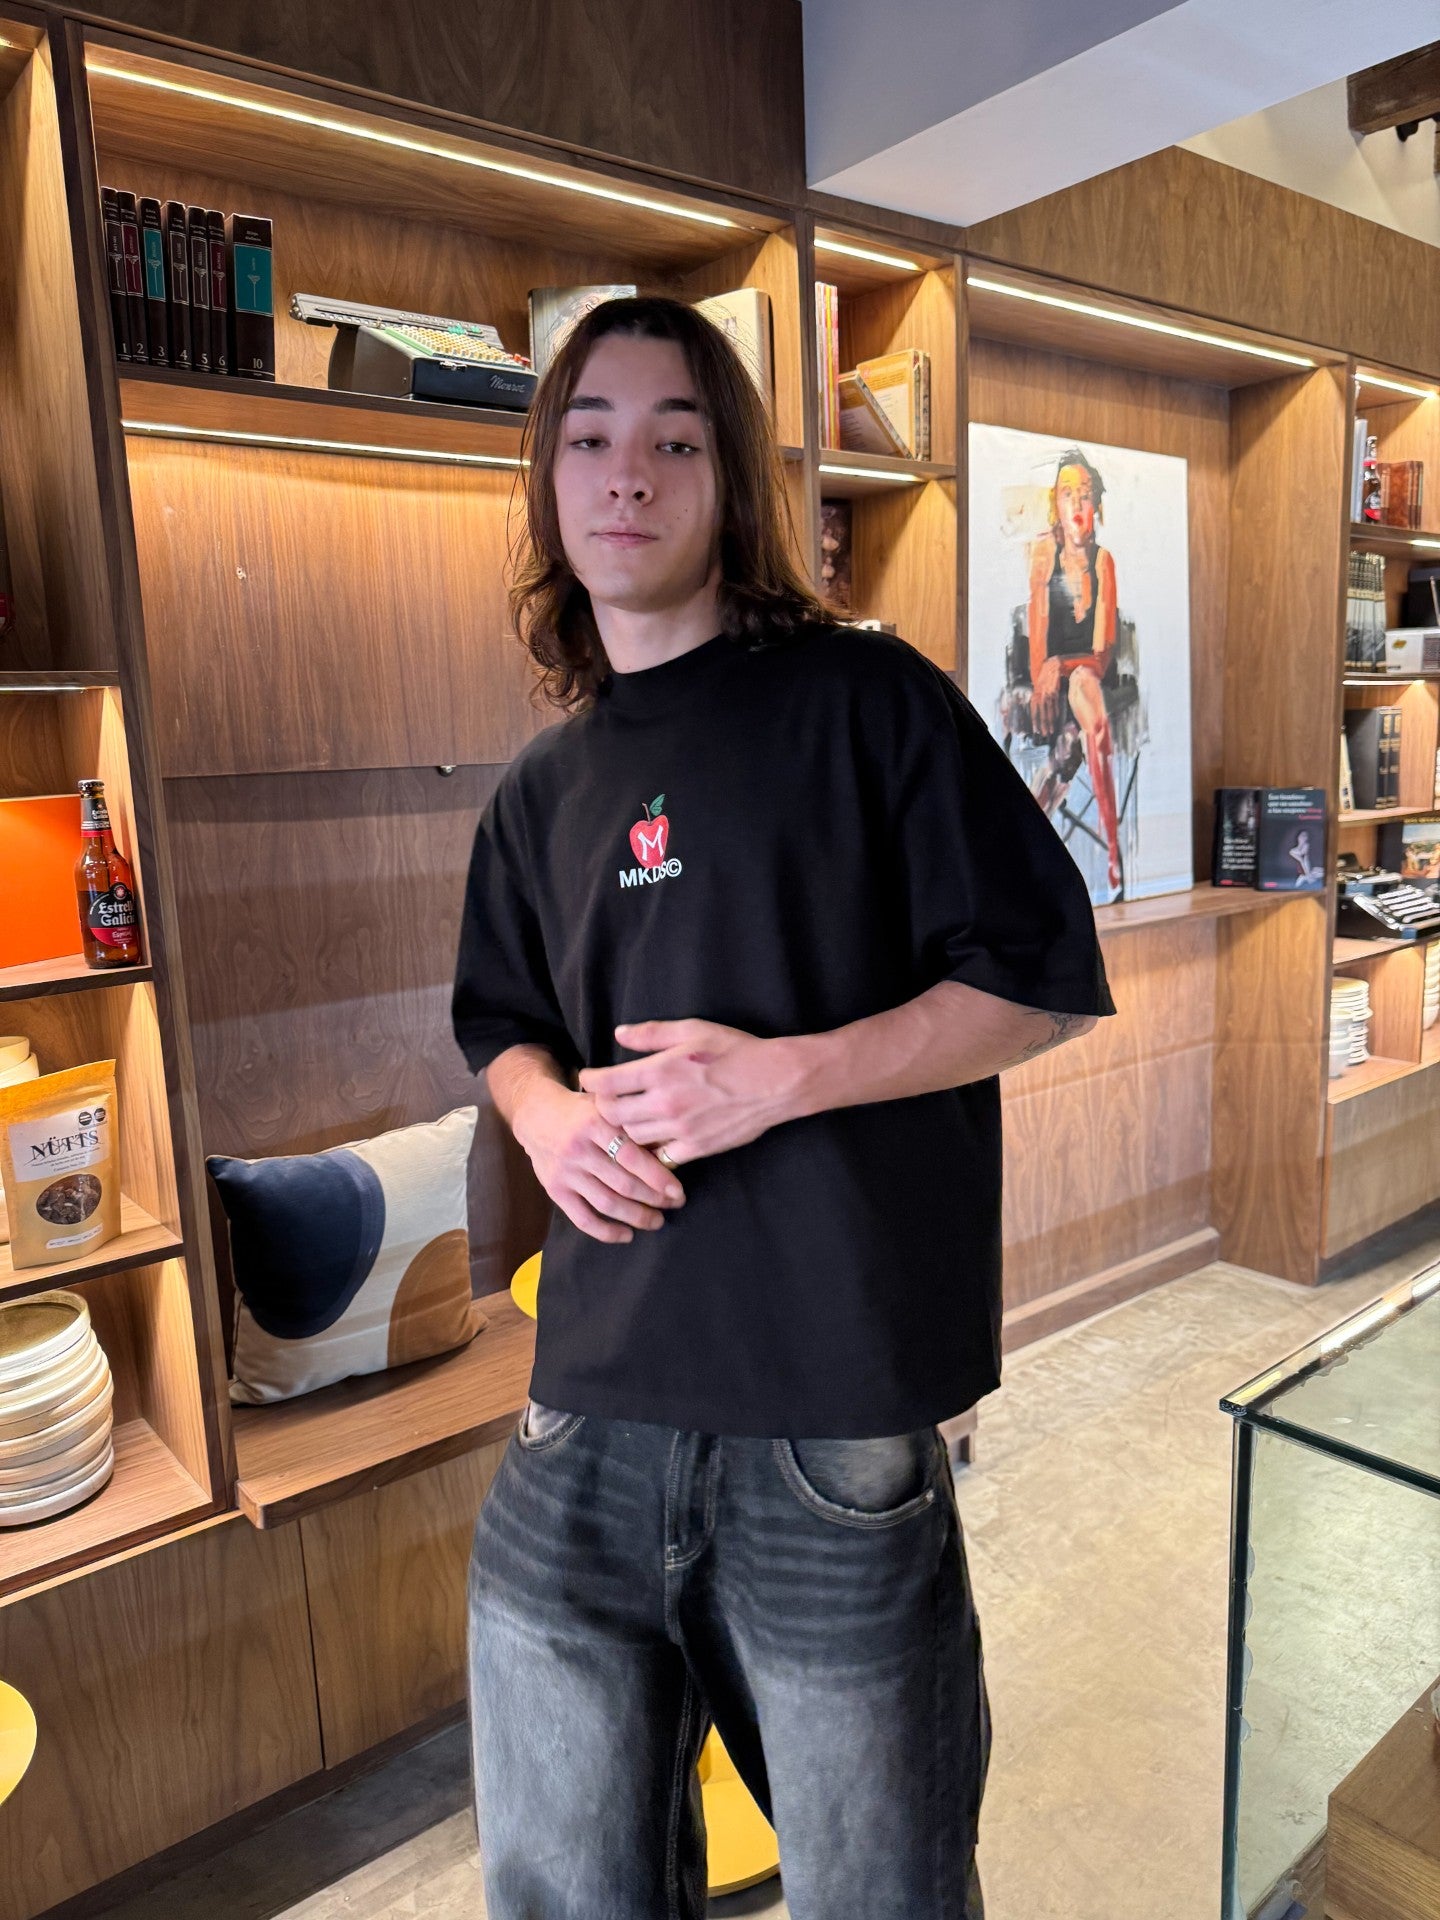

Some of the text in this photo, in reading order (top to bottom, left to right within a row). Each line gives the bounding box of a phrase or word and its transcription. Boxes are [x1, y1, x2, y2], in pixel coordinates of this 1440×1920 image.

[121, 342, 128, 354] 1
[136, 342, 145, 355] 2
[158, 345, 166, 357] 3
[179, 349, 188, 361] 4
[201, 353, 209, 364] 5
[218, 355, 227, 366] 6
[252, 357, 264, 370] 10
[637, 825, 664, 861] M
[98, 901, 134, 914] Estrell
[29, 1130, 99, 1160] NÜTTS
